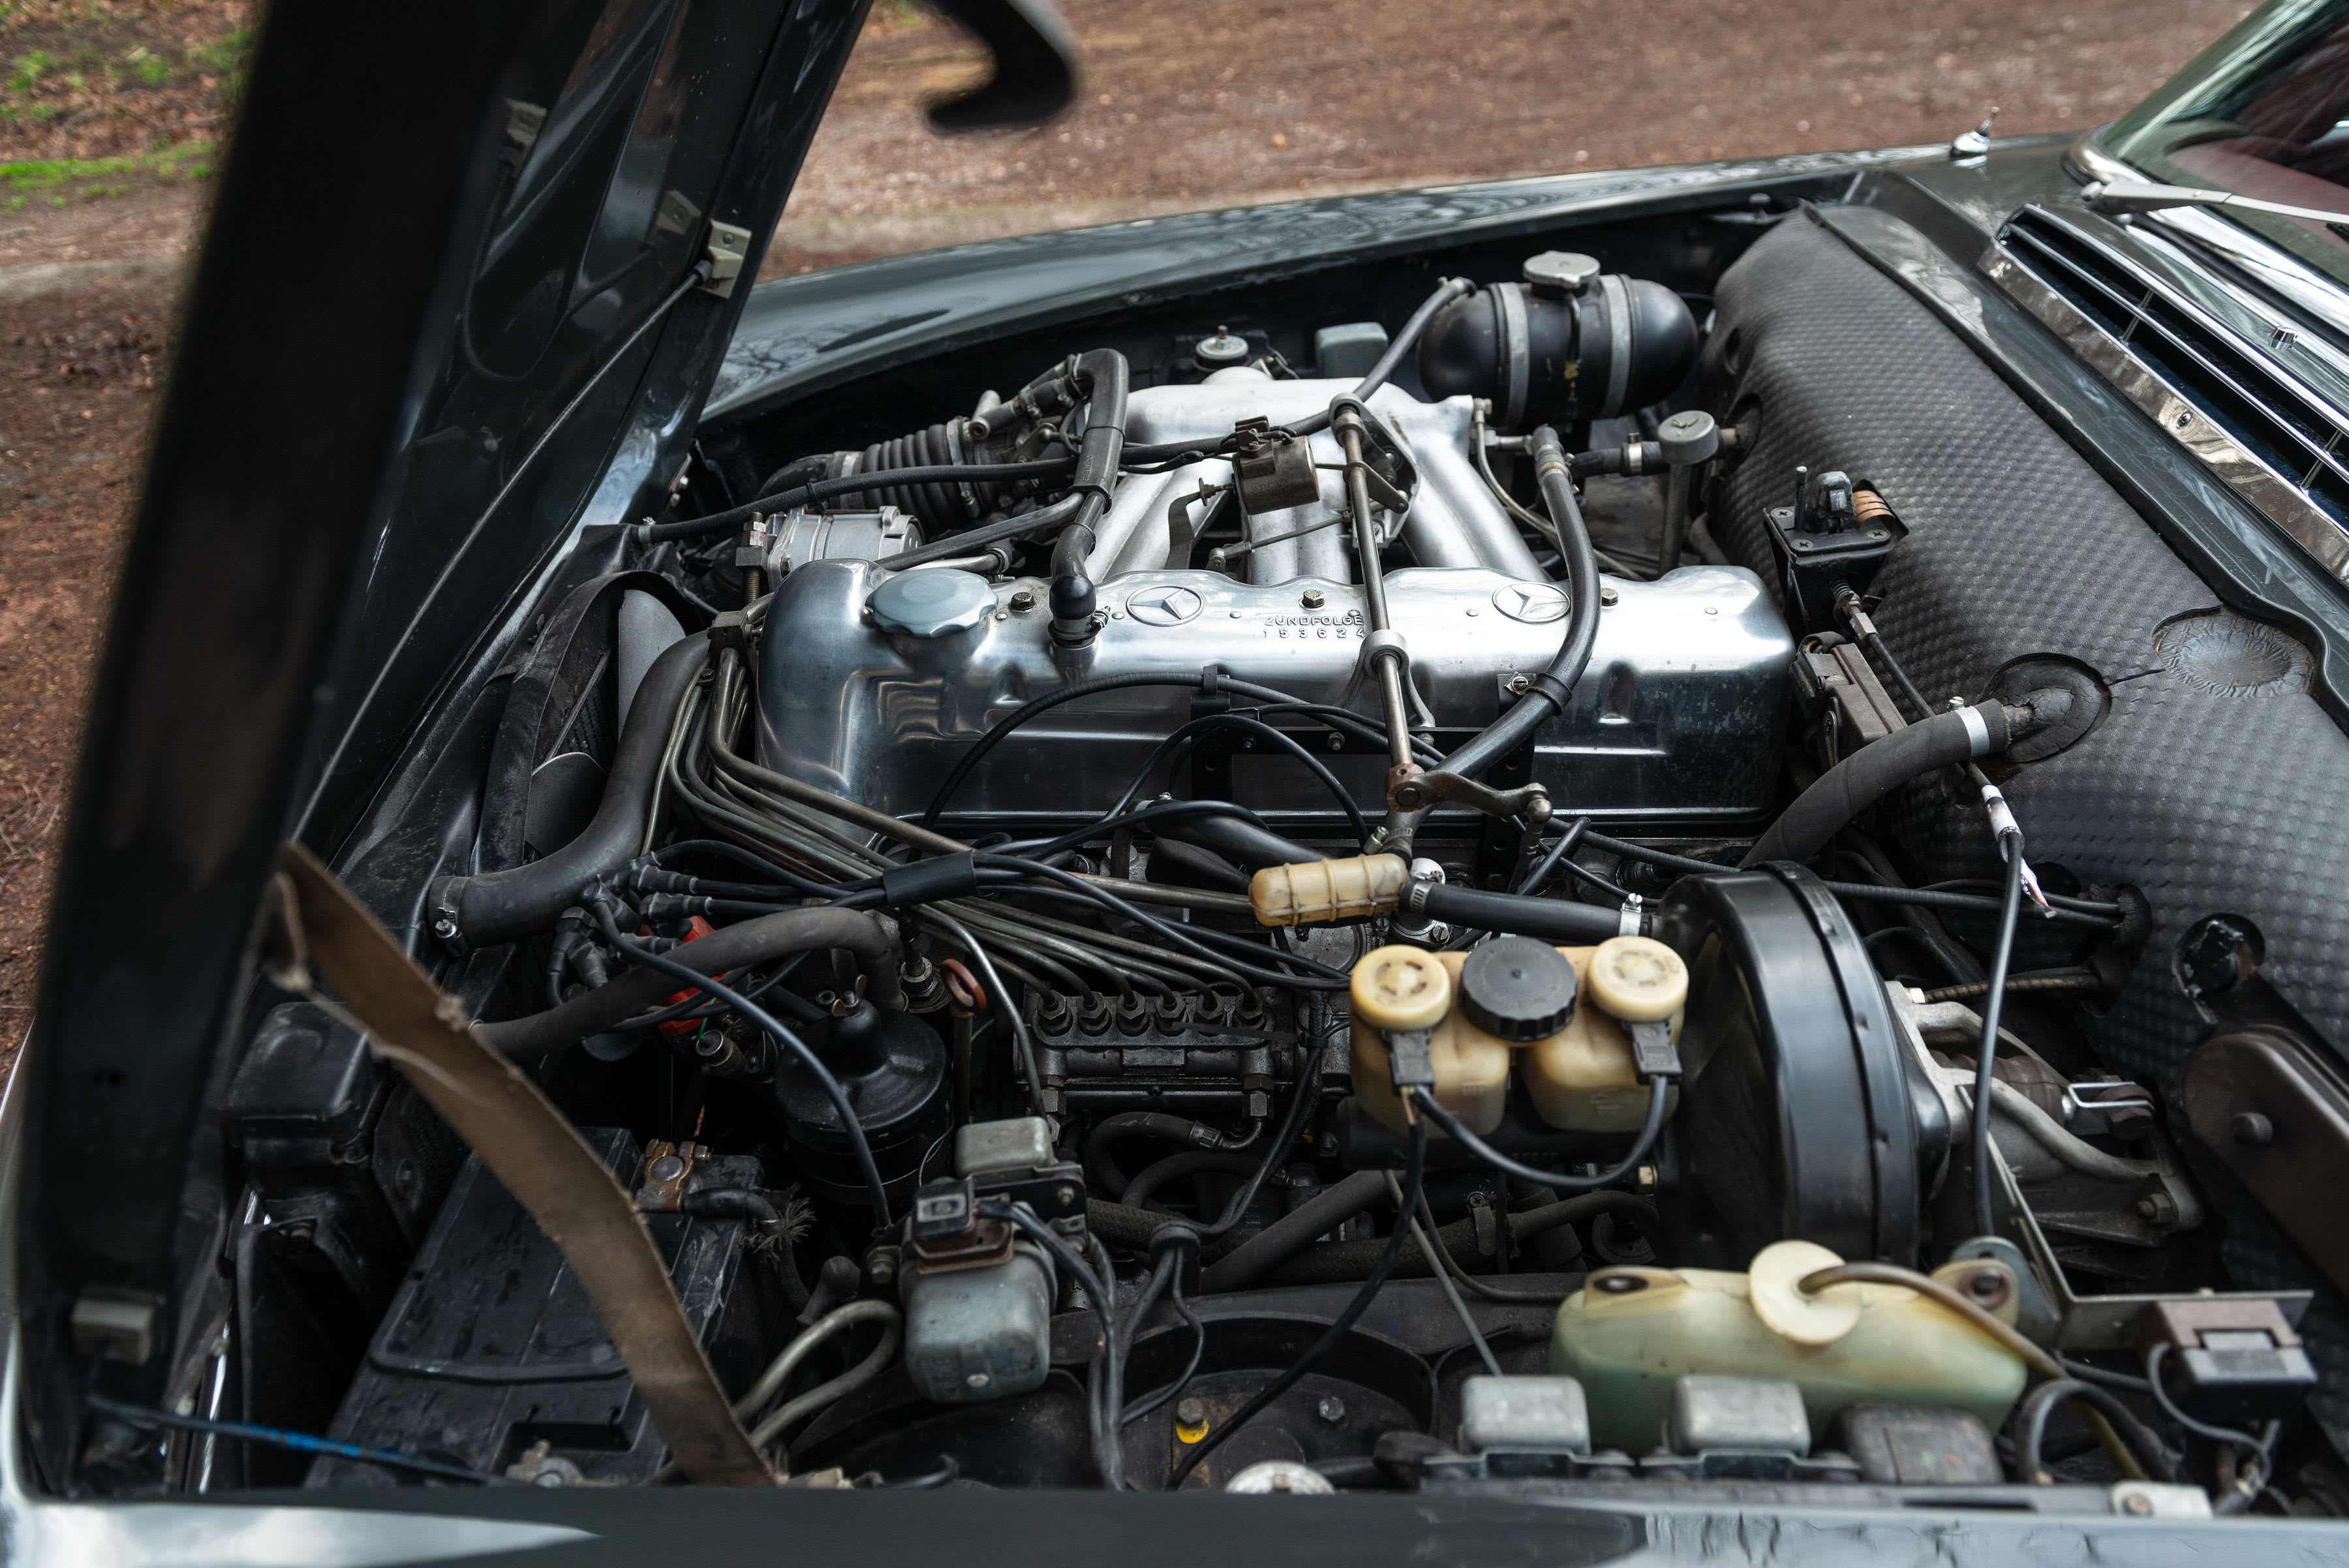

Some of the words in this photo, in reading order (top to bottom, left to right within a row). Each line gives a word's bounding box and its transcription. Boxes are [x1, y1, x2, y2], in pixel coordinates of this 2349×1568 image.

[1263, 615, 1364, 626] ZÜNDFOLGE
[1263, 629, 1269, 639] 1
[1280, 628, 1289, 639] 5
[1298, 628, 1308, 639] 3
[1317, 628, 1327, 639] 6
[1336, 628, 1346, 638] 2
[1356, 628, 1366, 638] 4
